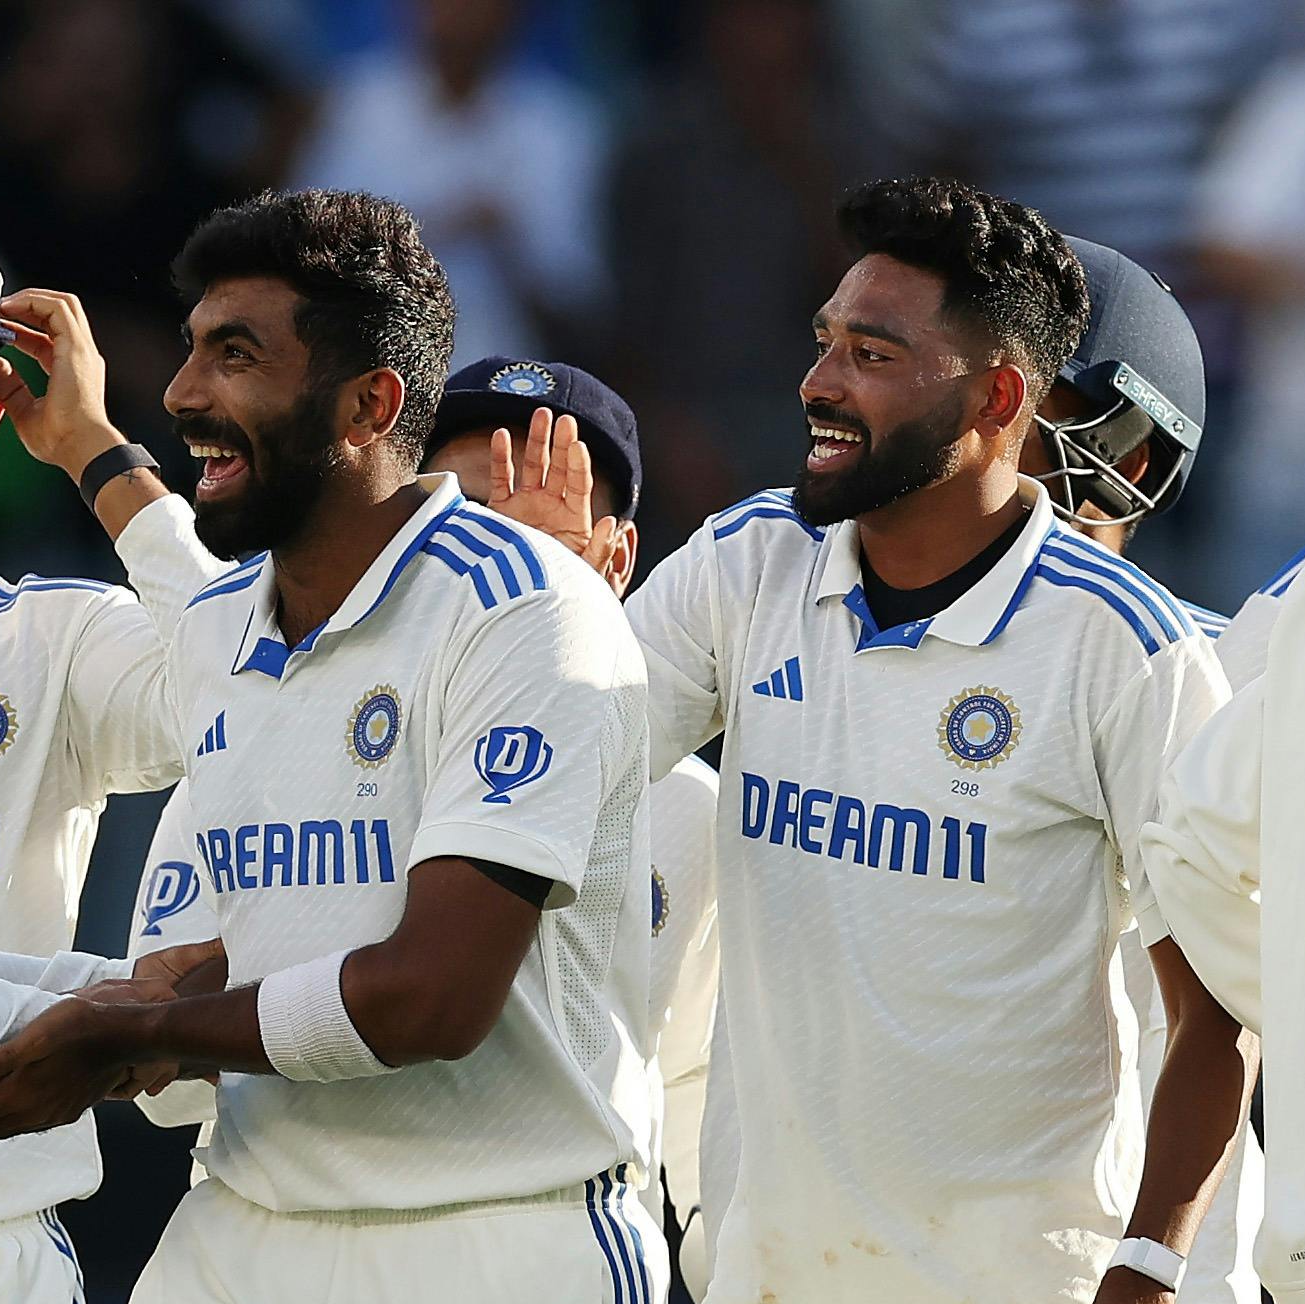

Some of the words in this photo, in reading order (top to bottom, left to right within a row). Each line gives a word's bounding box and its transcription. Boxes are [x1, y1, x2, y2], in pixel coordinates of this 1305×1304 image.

[1129, 380, 1173, 422] SHREY
[356, 782, 379, 798] 290
[950, 778, 980, 798] 298
[740, 771, 988, 884] DREAM11
